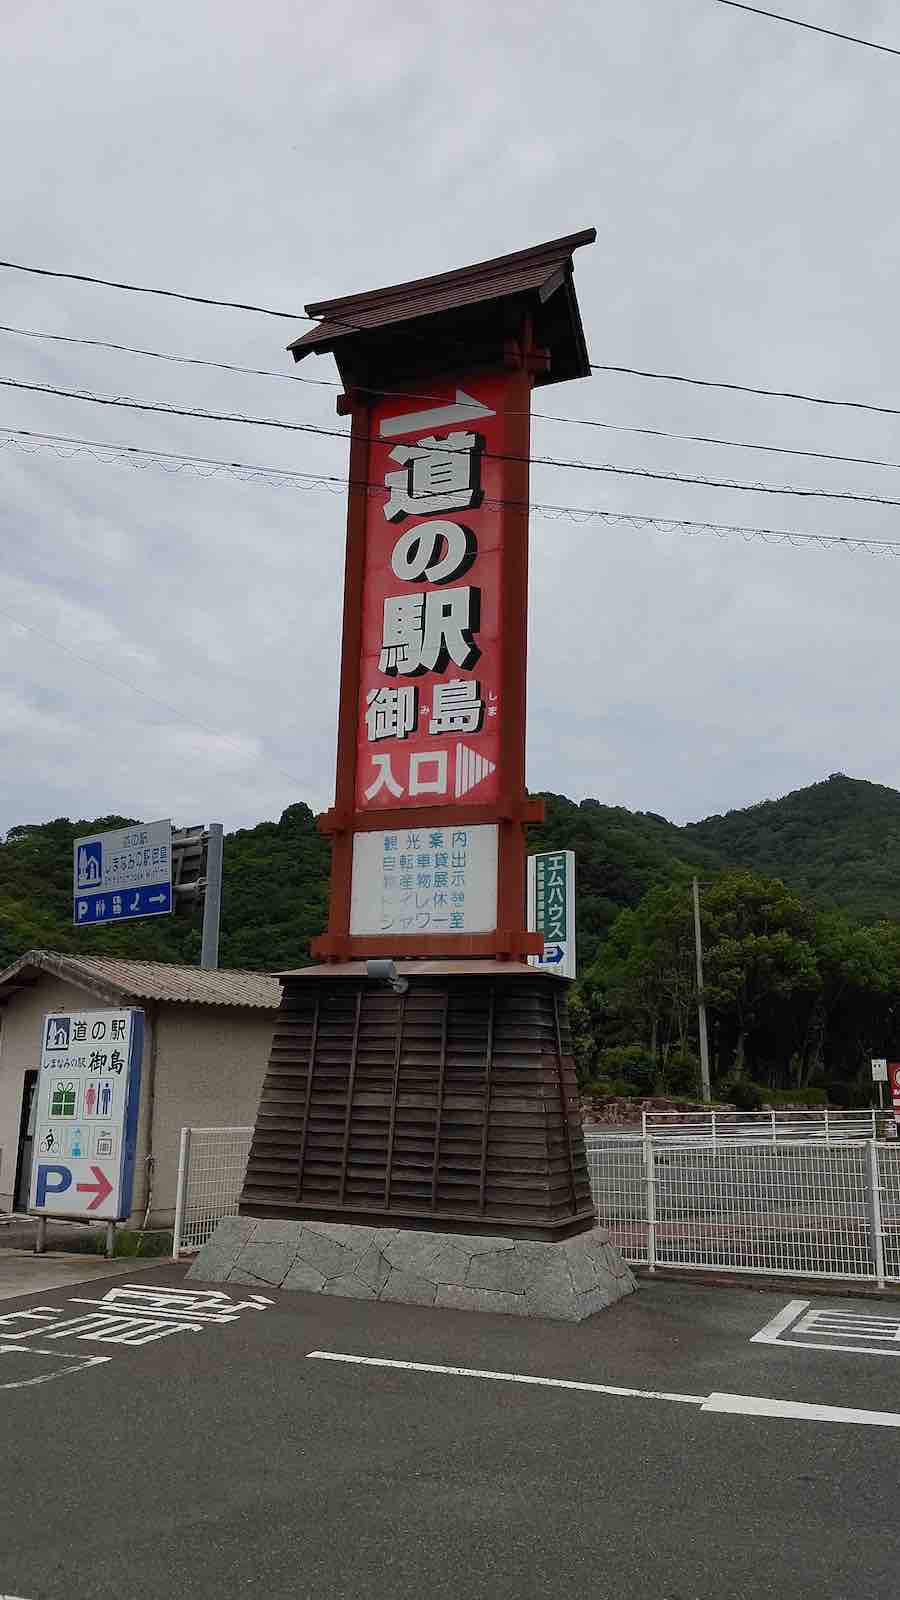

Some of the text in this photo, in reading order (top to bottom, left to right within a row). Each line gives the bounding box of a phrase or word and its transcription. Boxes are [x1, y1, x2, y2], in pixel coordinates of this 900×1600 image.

[378, 431, 483, 677] 道の駅
[364, 679, 486, 742] 御島
[364, 750, 448, 801] 入口
[383, 830, 468, 851] 観光案内
[383, 850, 465, 872] 自転車貸出
[78, 901, 89, 920] P
[547, 855, 565, 938] エムハウス
[72, 1019, 126, 1041] 道の駅
[88, 1049, 125, 1075] 御島
[35, 1165, 73, 1207] P
